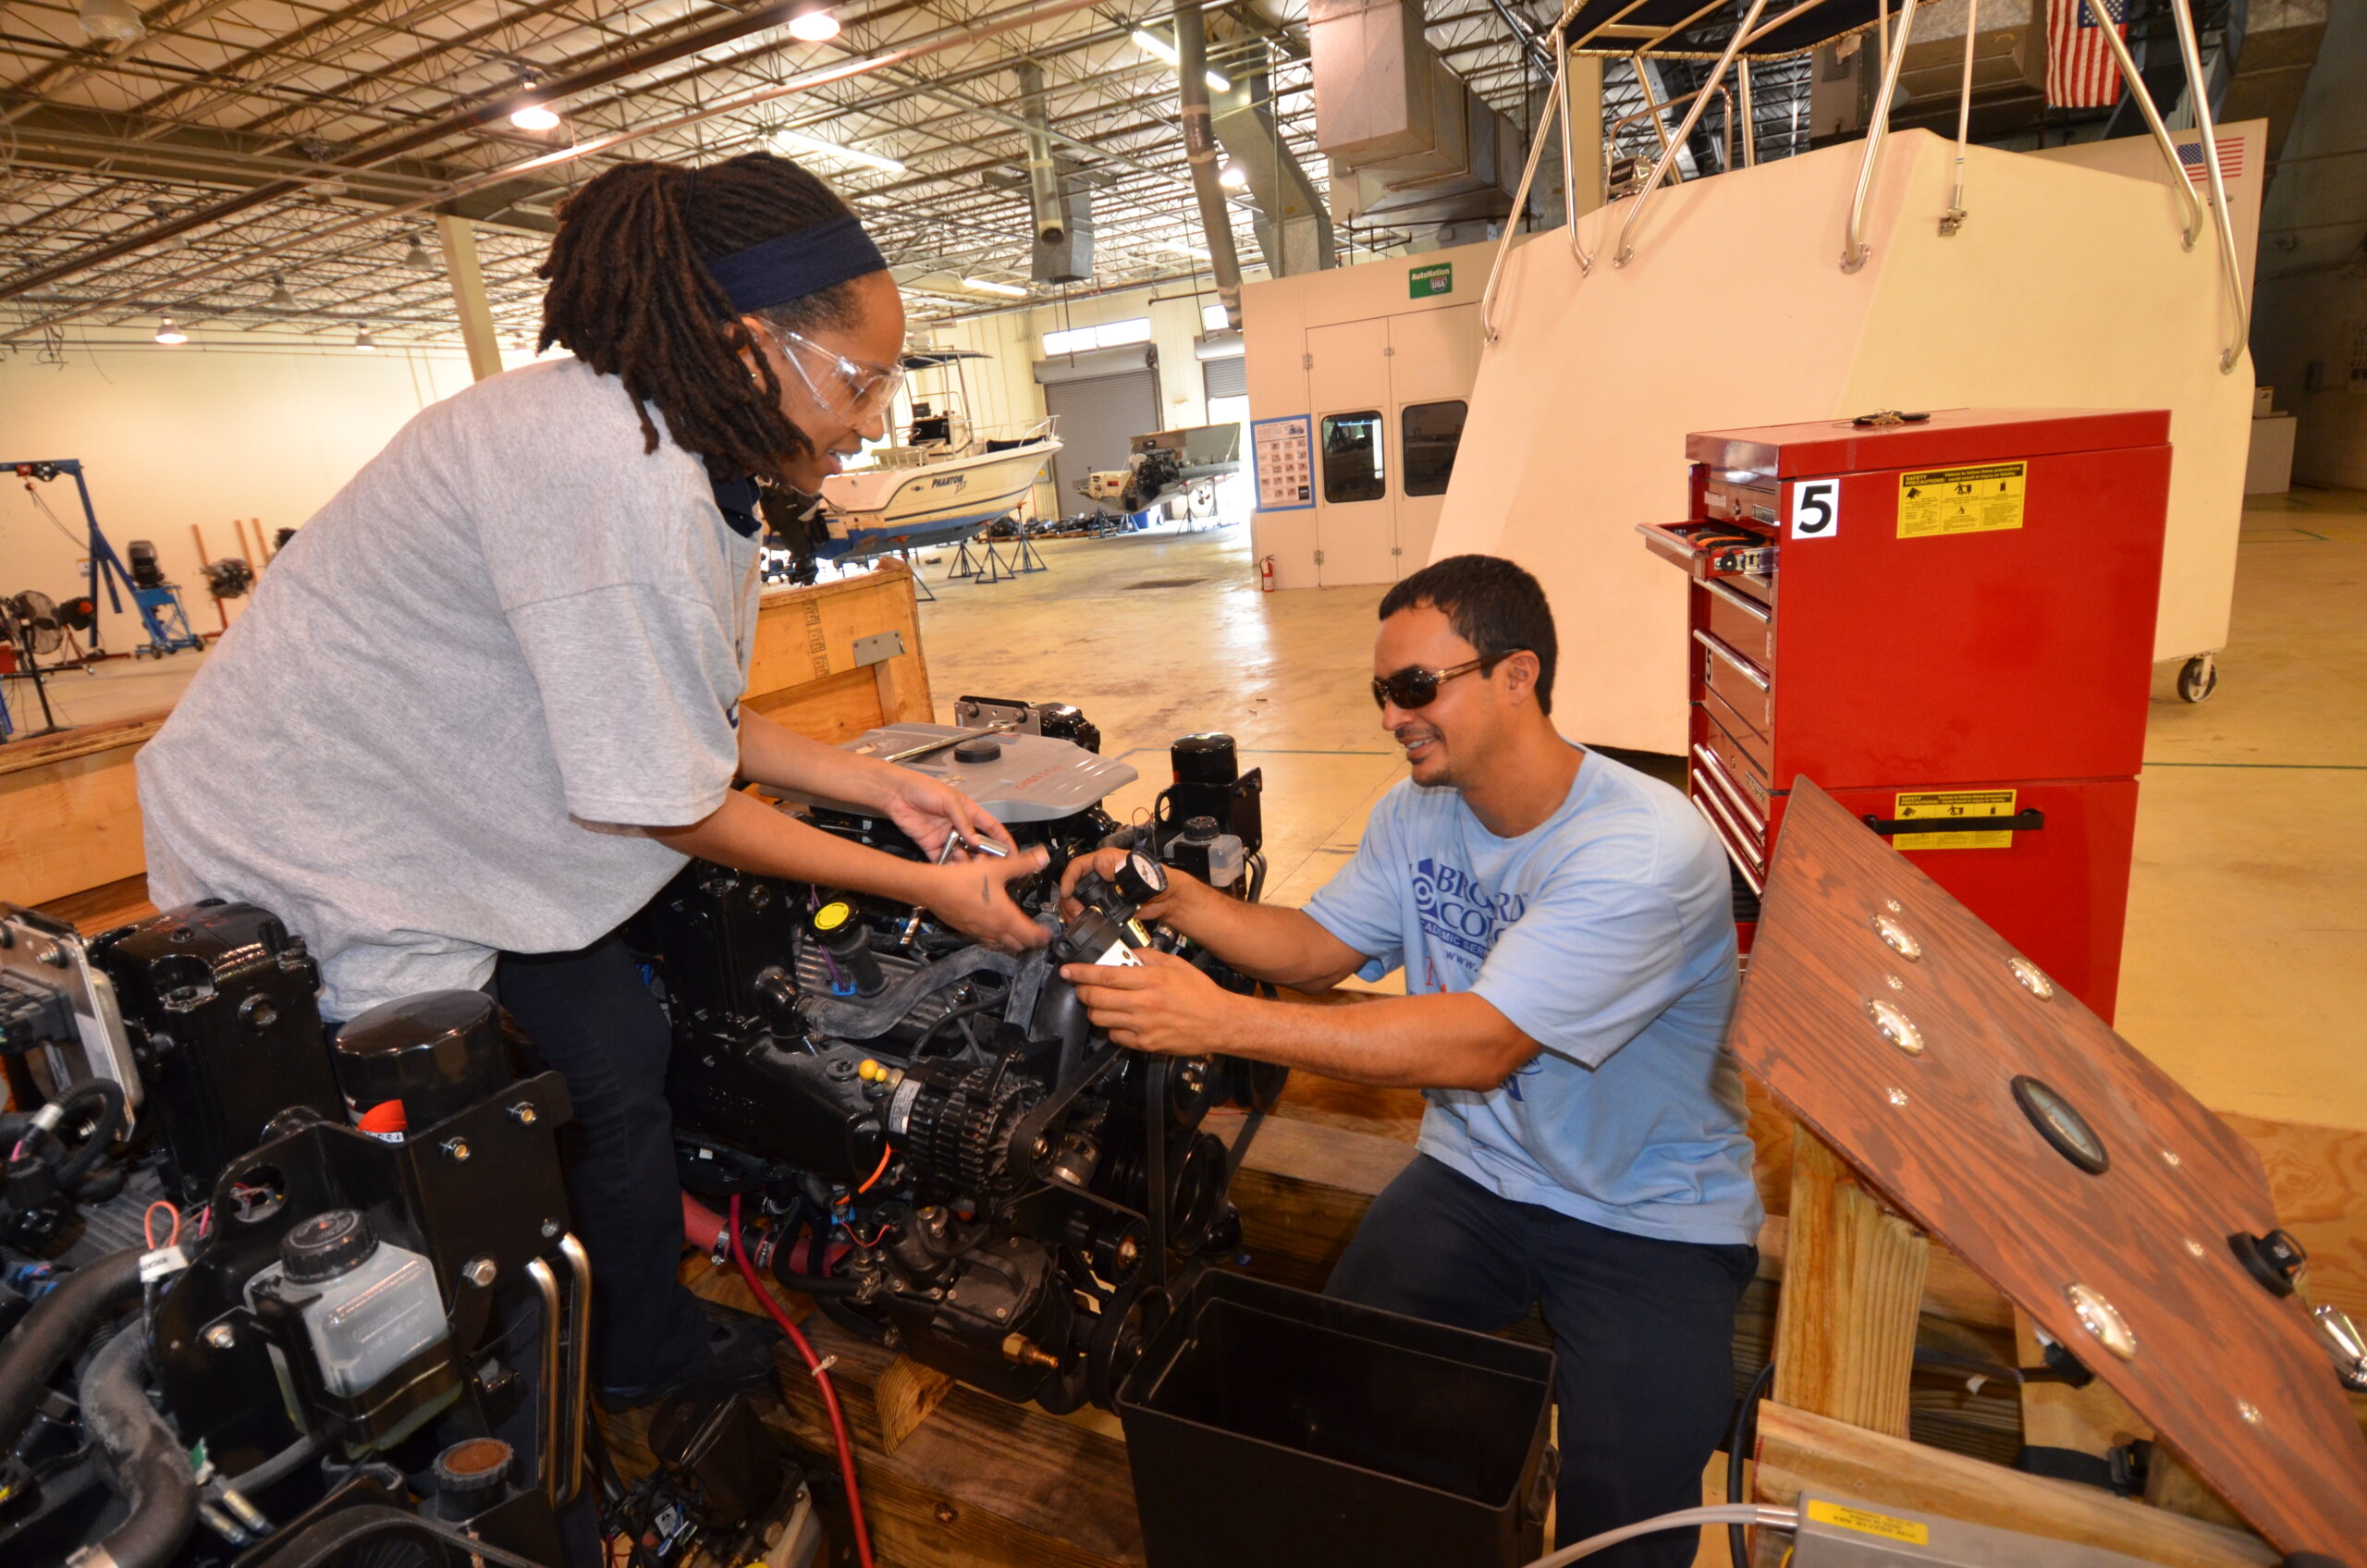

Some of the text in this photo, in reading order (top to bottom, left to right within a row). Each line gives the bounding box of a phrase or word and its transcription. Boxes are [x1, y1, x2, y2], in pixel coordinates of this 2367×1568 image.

[1412, 268, 1450, 281] AutoNation
[1432, 279, 1445, 288] USA
[931, 473, 964, 488] PHANTOM
[1798, 484, 1833, 534] 5
